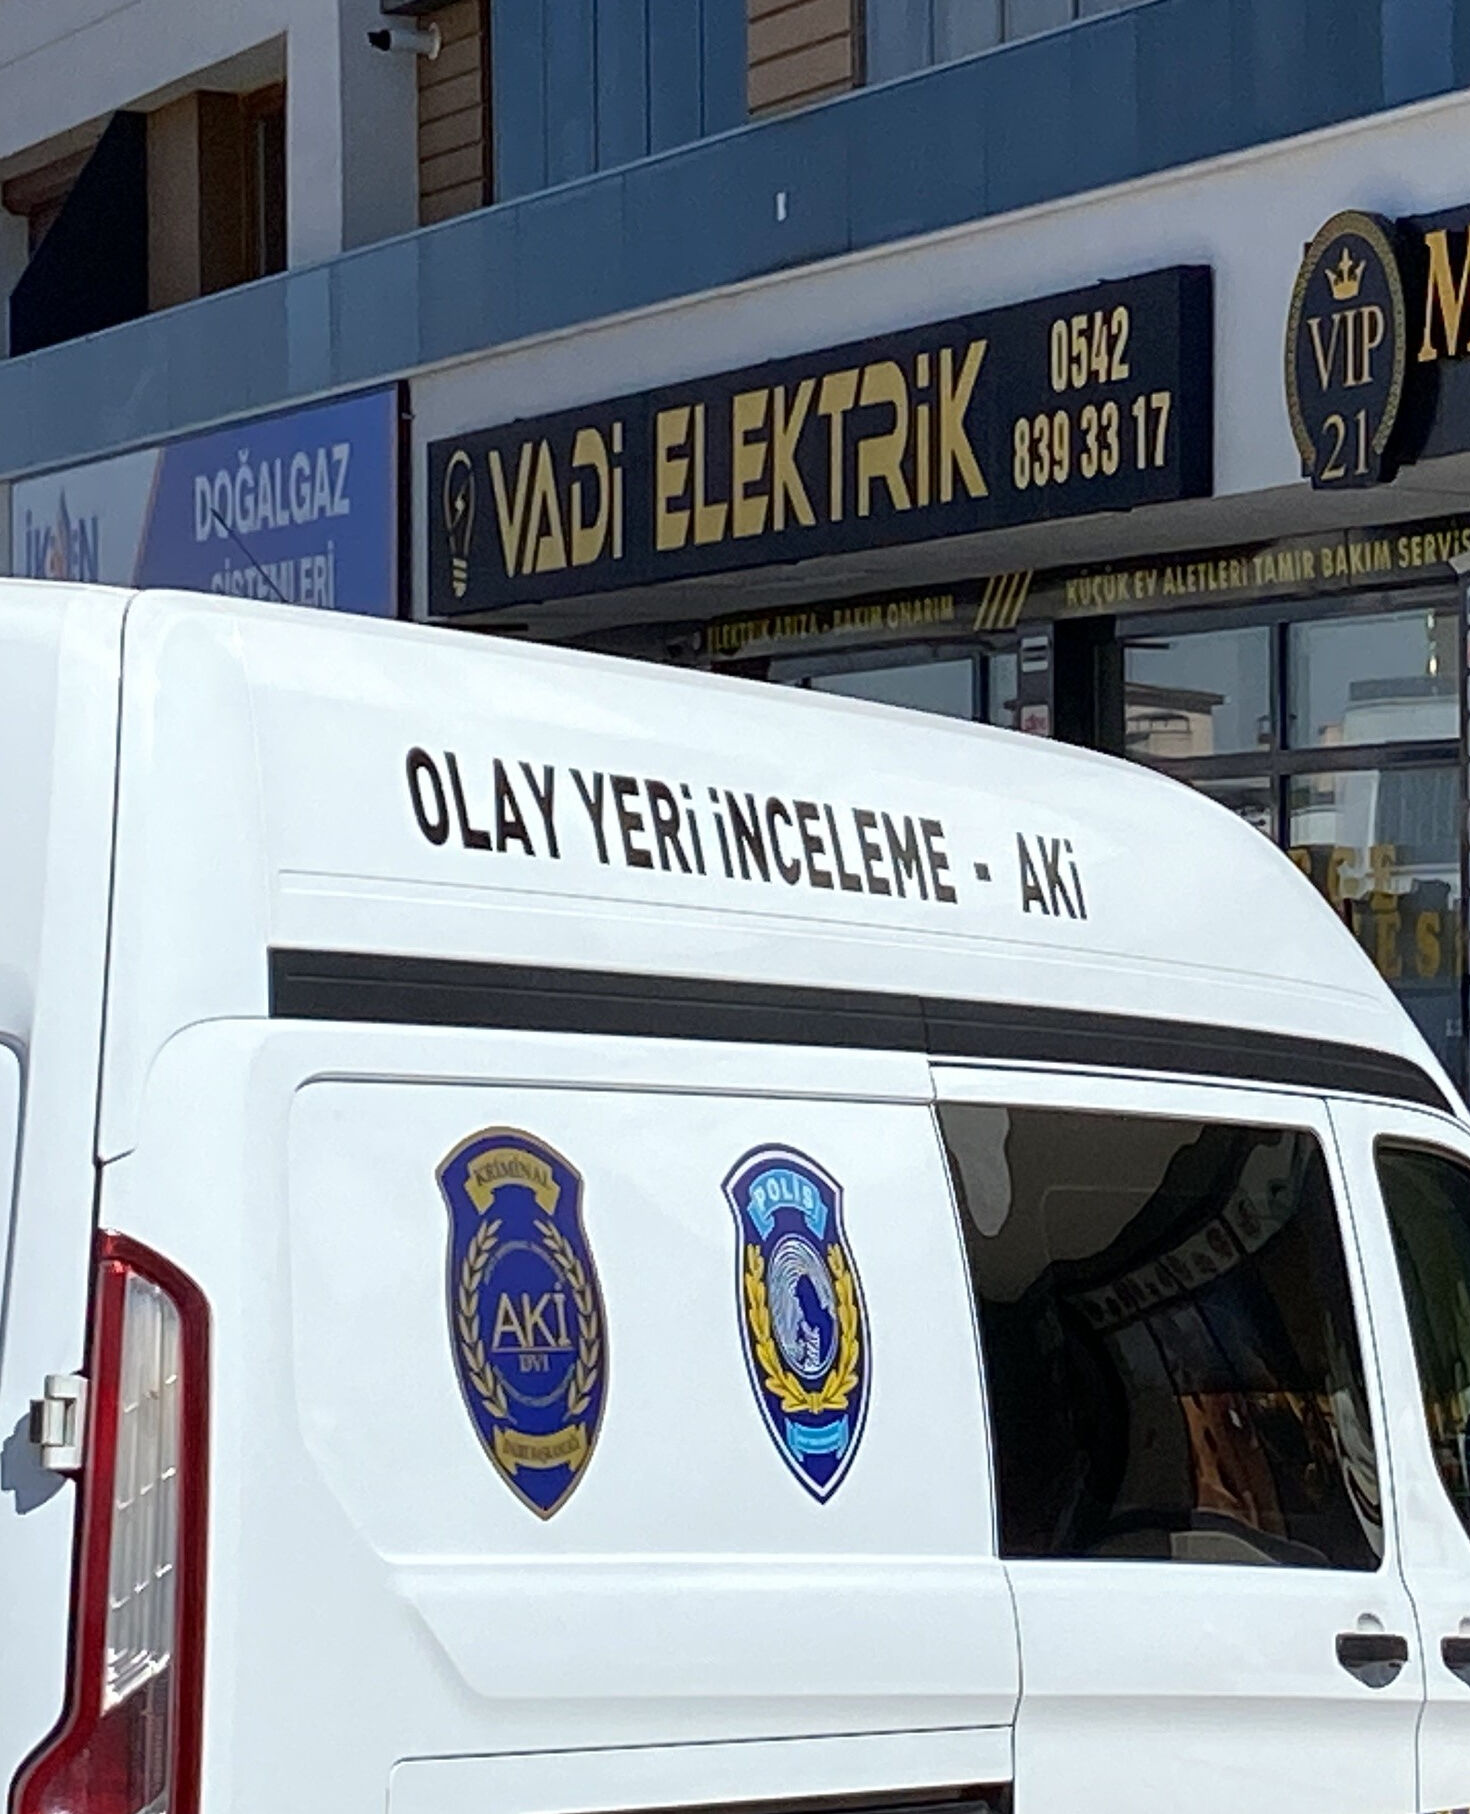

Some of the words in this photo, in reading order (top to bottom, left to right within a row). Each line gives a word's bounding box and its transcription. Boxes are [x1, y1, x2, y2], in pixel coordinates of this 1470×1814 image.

[1050, 305, 1130, 393] 0542
[1307, 304, 1385, 393] VIP
[1013, 409, 1070, 490] 839
[1080, 400, 1120, 480] 33
[1132, 390, 1172, 470] 17
[1320, 408, 1369, 481] 21
[195, 443, 350, 542] DOĞALGAZ
[1134, 571, 1155, 599] EV
[1321, 539, 1392, 575] BAKIM
[405, 745, 561, 860] OLAY
